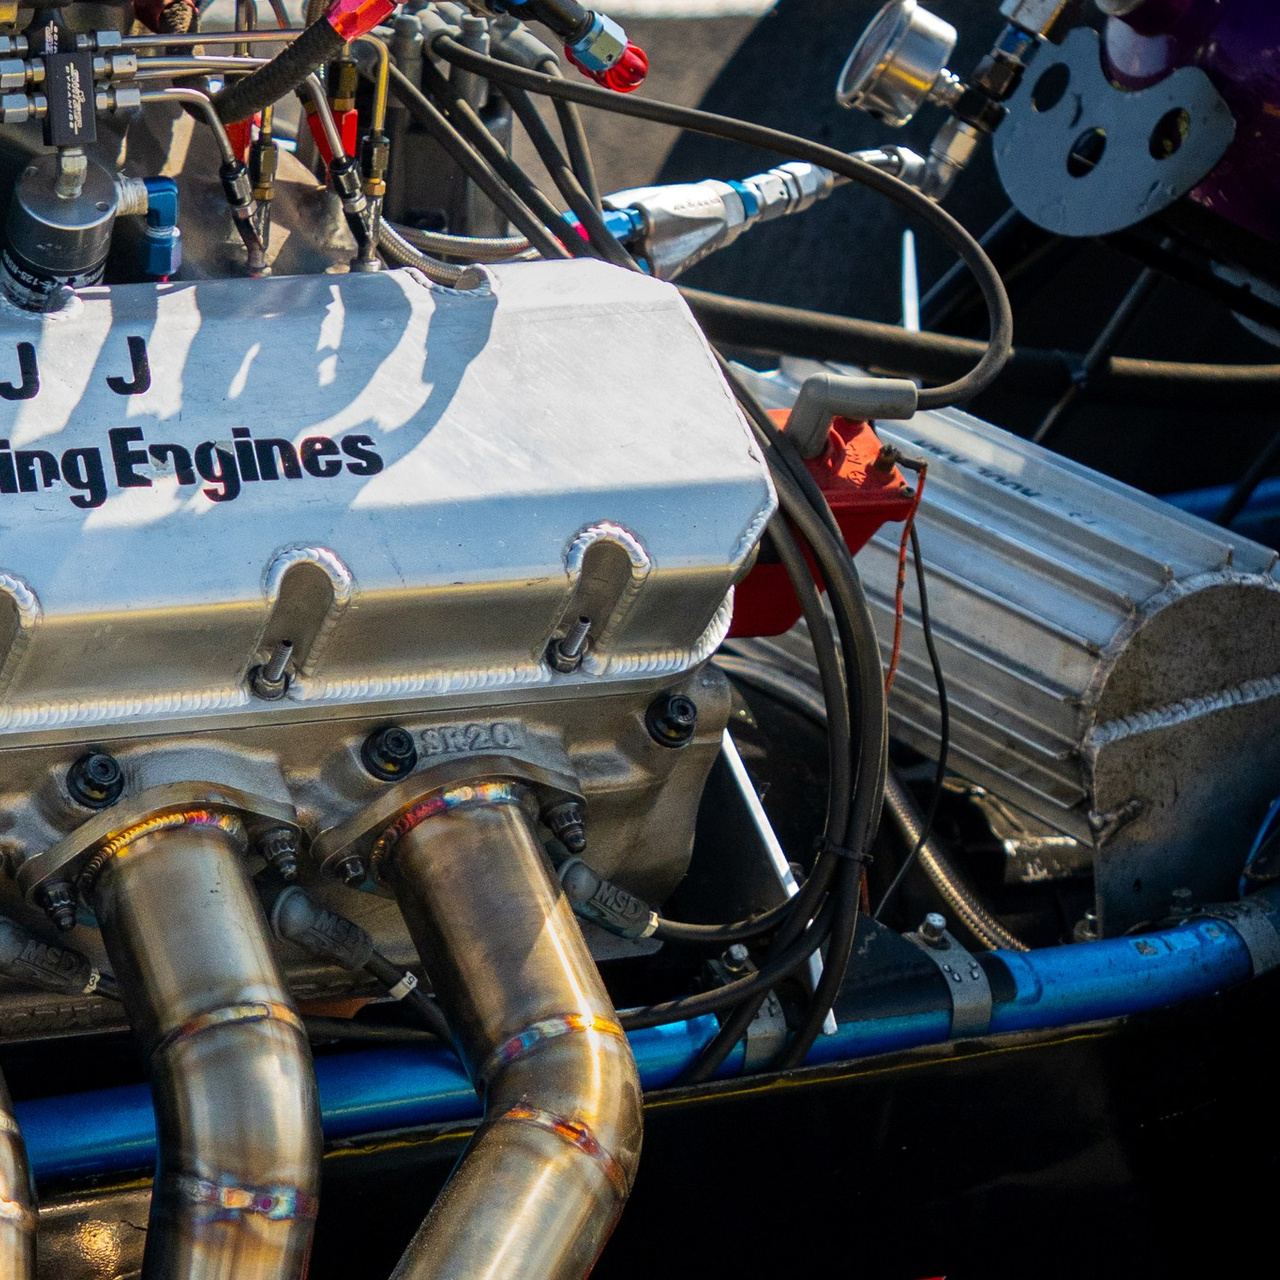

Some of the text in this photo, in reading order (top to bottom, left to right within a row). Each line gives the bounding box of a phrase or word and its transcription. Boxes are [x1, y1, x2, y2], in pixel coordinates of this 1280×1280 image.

[106, 335, 152, 396] J
[108, 425, 384, 503] Engines
[594, 880, 642, 920] MSD
[89, 975, 97, 987] 3
[406, 975, 415, 985] 5
